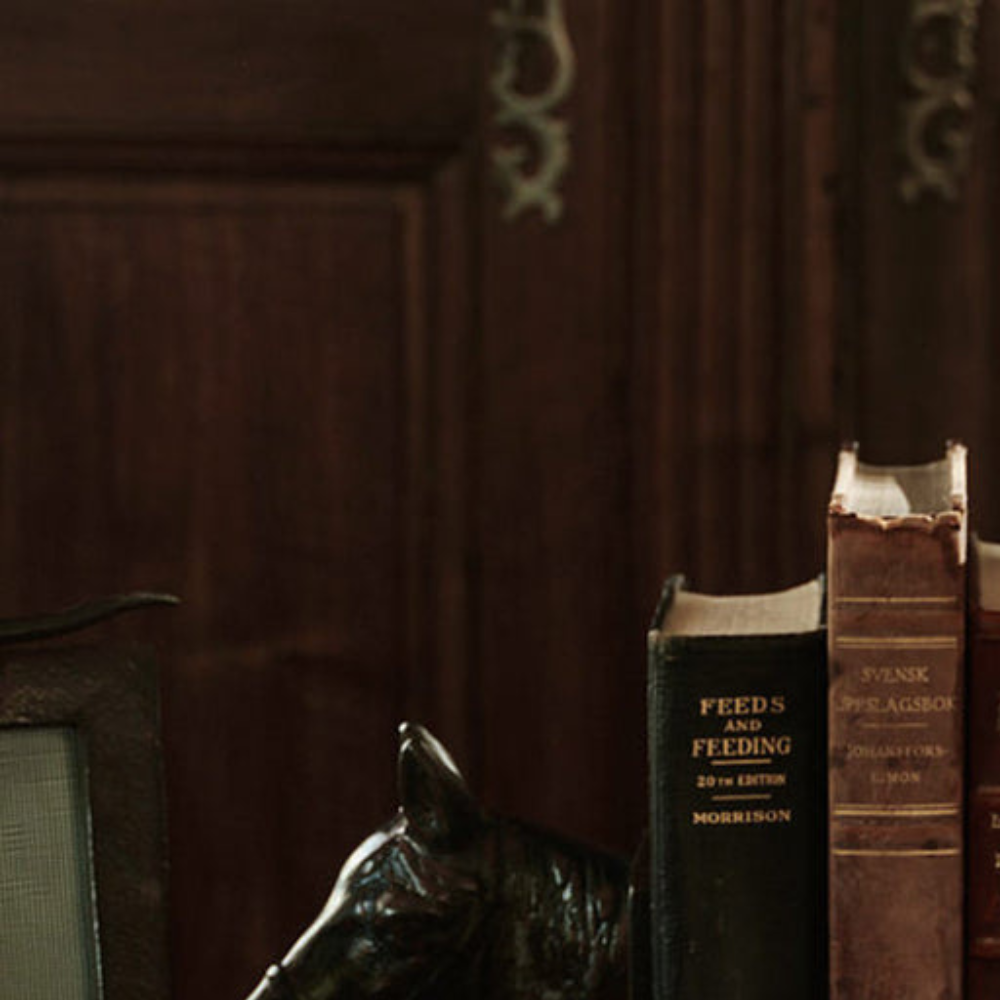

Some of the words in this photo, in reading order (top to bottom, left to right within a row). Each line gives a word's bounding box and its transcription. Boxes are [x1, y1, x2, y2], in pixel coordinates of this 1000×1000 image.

[860, 666, 930, 684] SVENSK
[700, 695, 787, 717] FEEDS
[723, 718, 763, 733] AND
[691, 736, 793, 758] FEEDING
[737, 773, 787, 787] EDITION
[692, 809, 792, 825] MORRISON
